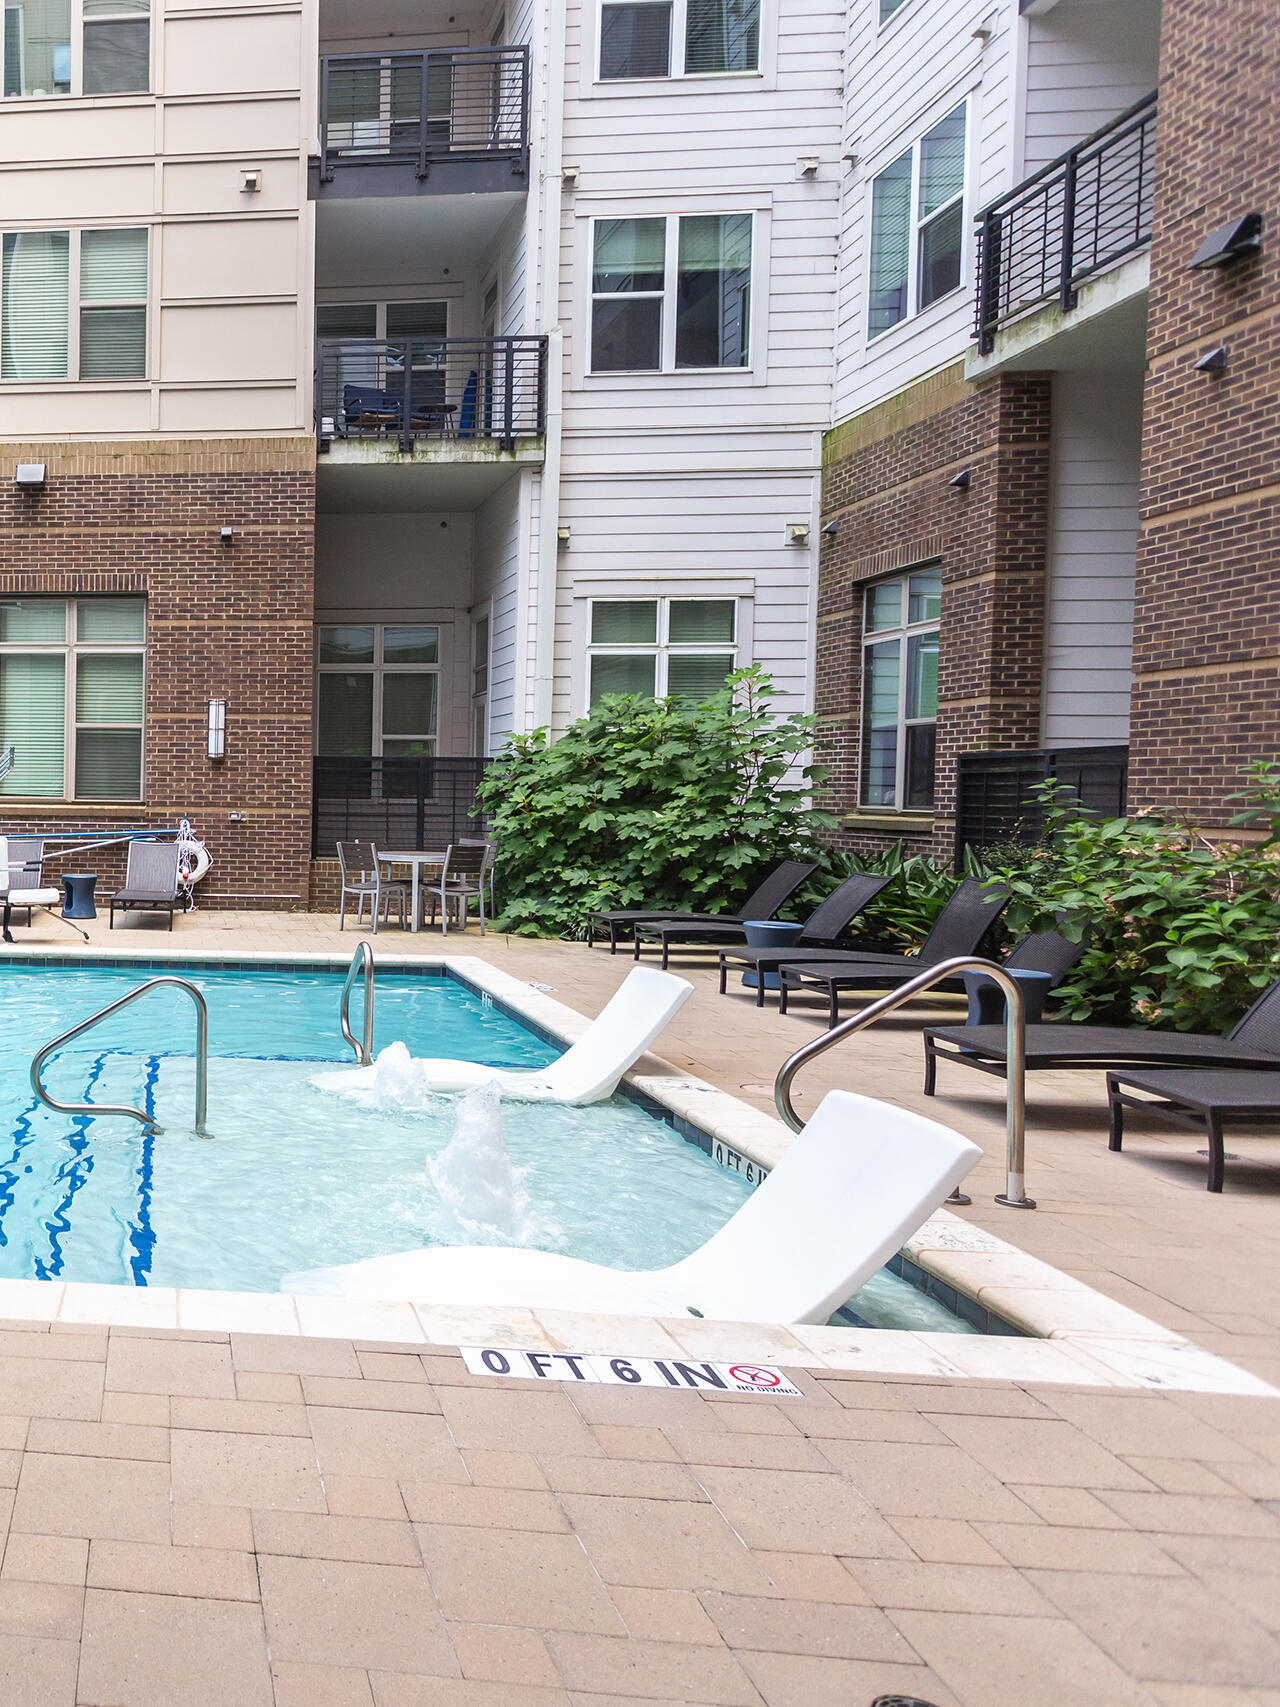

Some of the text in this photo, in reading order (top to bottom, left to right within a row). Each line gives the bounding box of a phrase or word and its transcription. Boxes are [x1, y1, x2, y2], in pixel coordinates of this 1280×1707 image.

[727, 1149, 741, 1172] FT
[746, 1162, 754, 1183] 6
[481, 1349, 728, 1390] 0 FT 6 IN
[757, 1387, 798, 1395] DIVING
